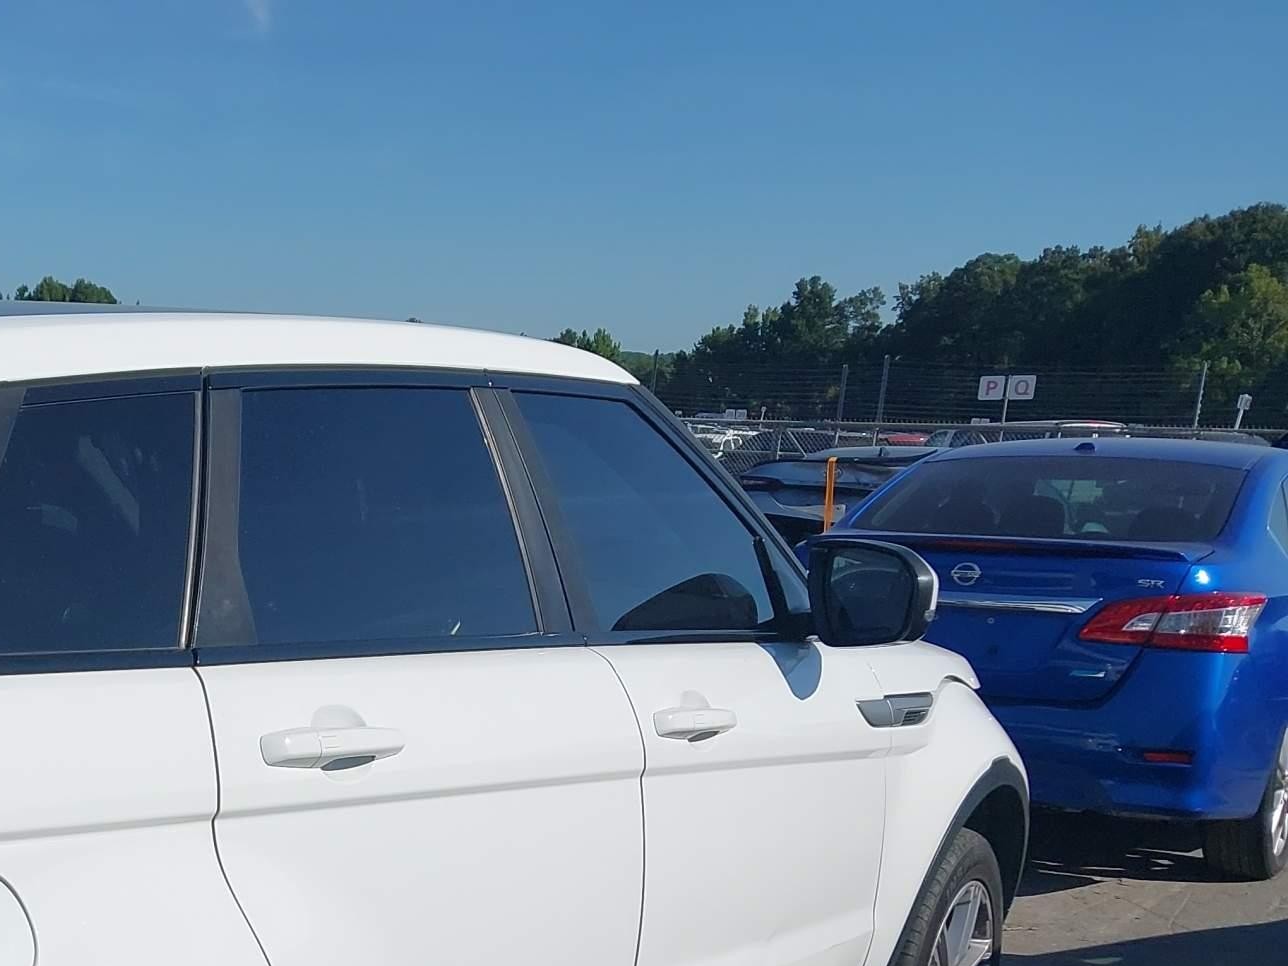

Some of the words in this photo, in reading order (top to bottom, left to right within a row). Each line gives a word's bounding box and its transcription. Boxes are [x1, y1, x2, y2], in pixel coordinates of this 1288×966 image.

[986, 380, 999, 396] P
[1015, 380, 1031, 396] Q
[1137, 578, 1165, 589] SR
